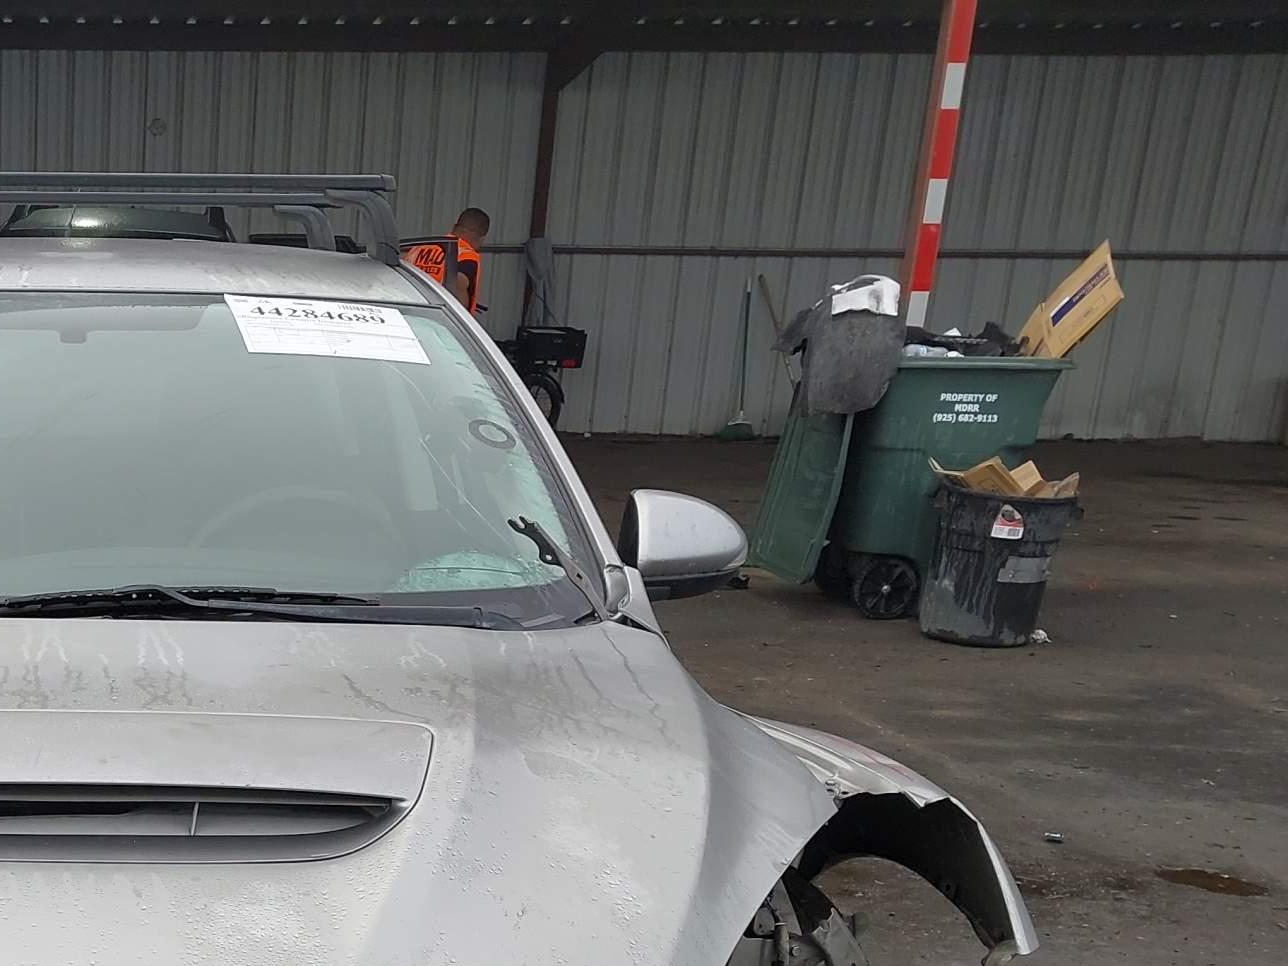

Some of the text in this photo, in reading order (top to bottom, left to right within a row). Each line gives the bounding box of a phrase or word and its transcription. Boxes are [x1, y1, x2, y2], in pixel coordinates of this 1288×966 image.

[250, 306, 386, 325] 44284689
[940, 393, 998, 402] PROPERTY OF
[954, 403, 980, 412] MDRR
[933, 413, 998, 423] (925) 682-9113
